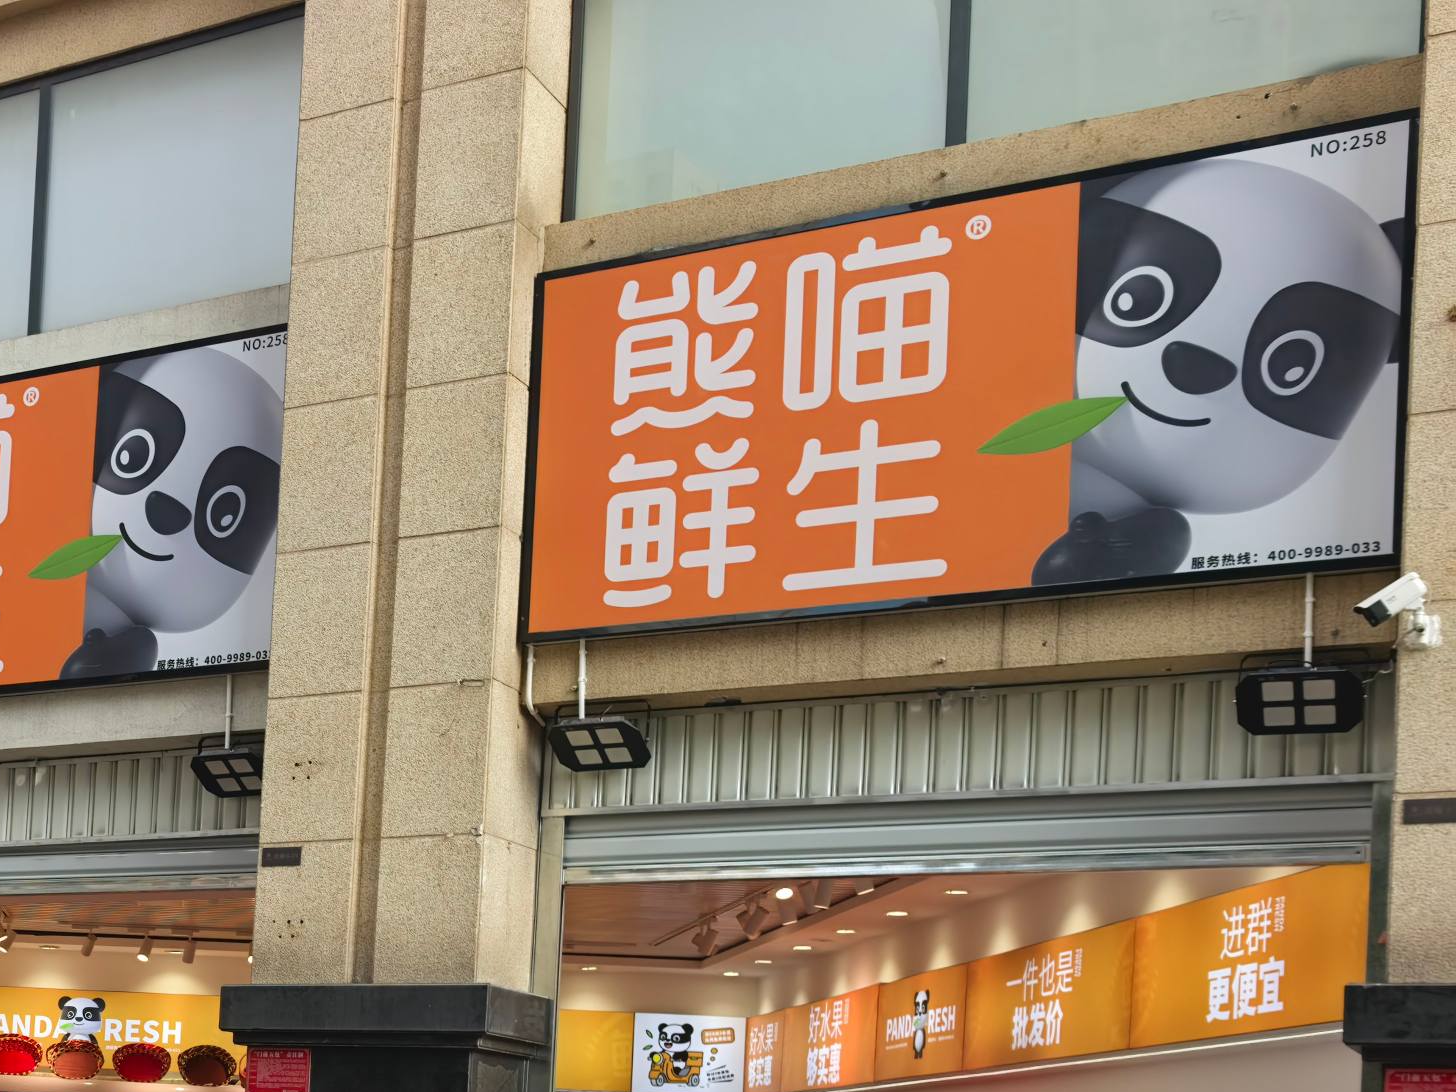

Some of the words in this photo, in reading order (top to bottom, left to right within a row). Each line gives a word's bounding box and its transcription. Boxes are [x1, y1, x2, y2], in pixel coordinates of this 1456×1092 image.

[1311, 130, 1386, 157] NO:258
[610, 225, 953, 438] 熊喵
[602, 419, 948, 609] 鲜生
[157, 650, 271, 670] 服务热线：400-9989-03
[1220, 897, 1272, 960] 进群
[1006, 950, 1073, 1001] 一件也是
[1206, 956, 1286, 1023] 更便宜
[100, 1018, 182, 1045] RESH
[808, 1000, 843, 1043] 好水果
[927, 1005, 956, 1034] RESH
[1012, 999, 1064, 1050] 批发价
[807, 1043, 842, 1086] 够实惠
